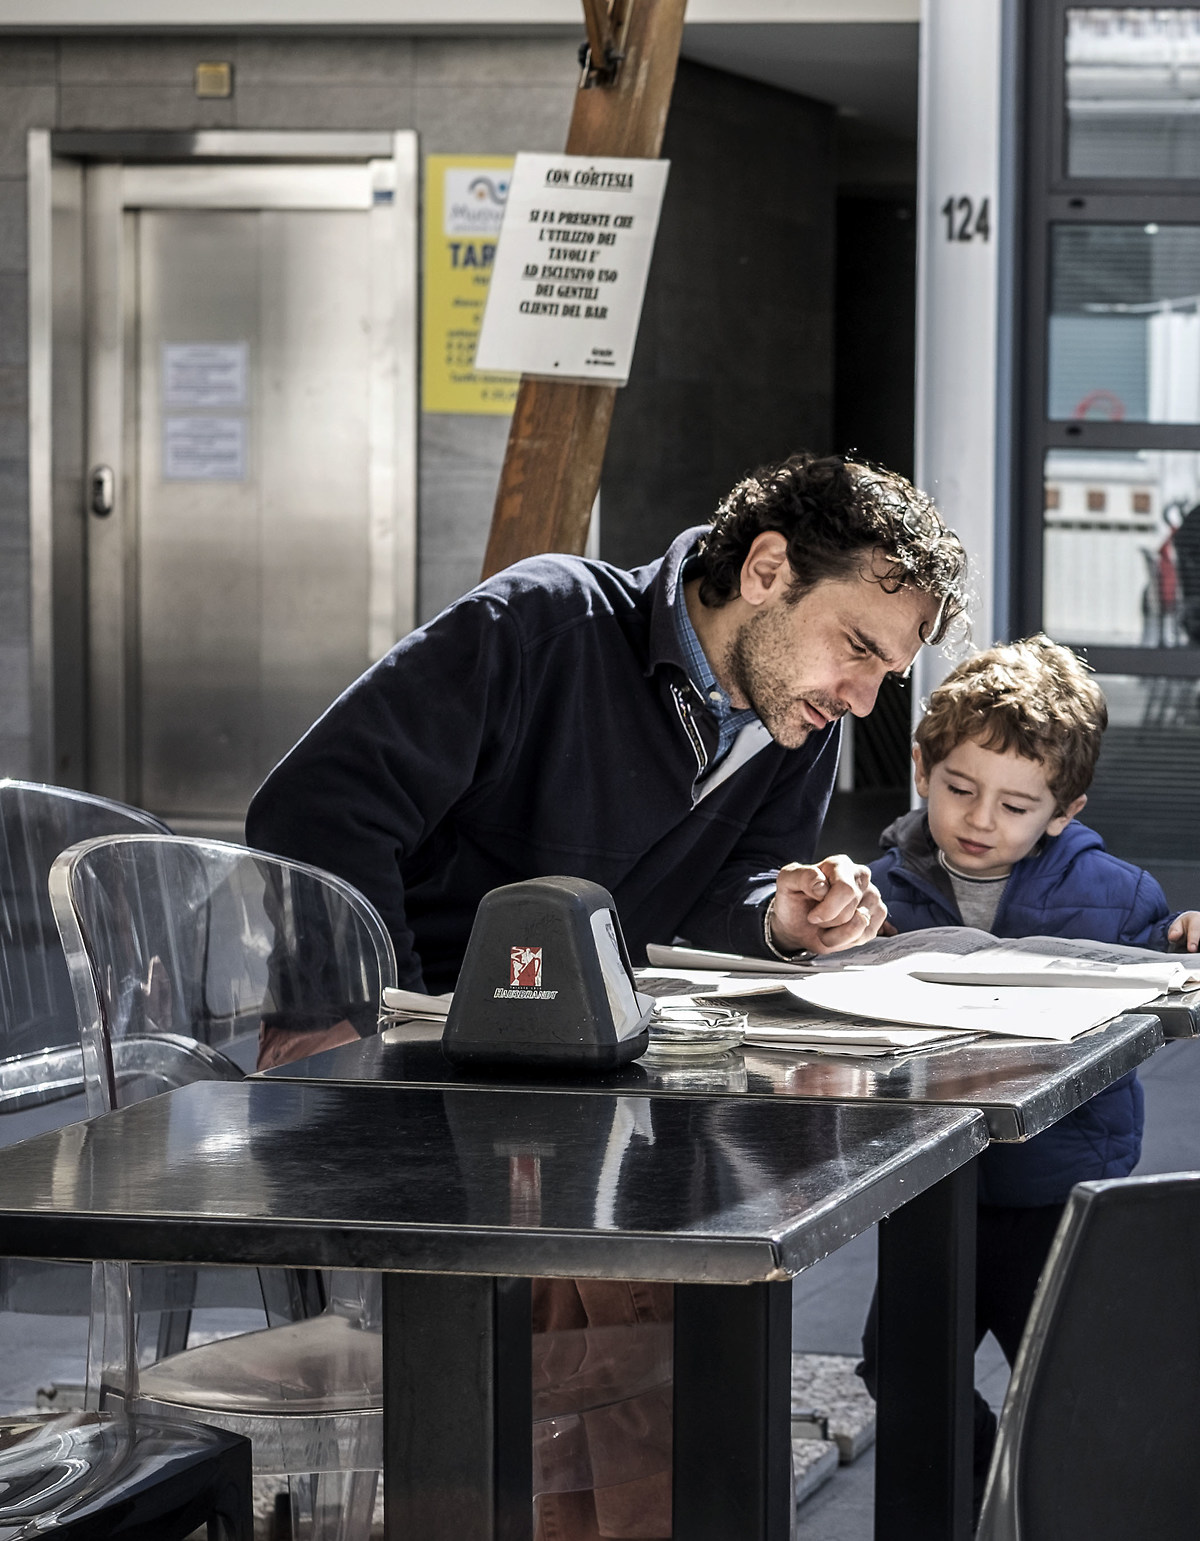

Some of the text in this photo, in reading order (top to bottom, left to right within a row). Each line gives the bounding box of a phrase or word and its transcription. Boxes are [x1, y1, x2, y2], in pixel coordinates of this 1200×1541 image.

[546, 169, 634, 188] CON CORTESIA
[530, 209, 634, 229] SI FA PRESENTE CHE
[942, 196, 990, 242] 124
[539, 228, 617, 246] L'UTILIZZO DEI
[549, 247, 587, 262] TAVOLI
[524, 264, 538, 277] AD
[535, 284, 599, 300] DEI GENTILI
[519, 301, 608, 319] CLIENTI DEL BAR
